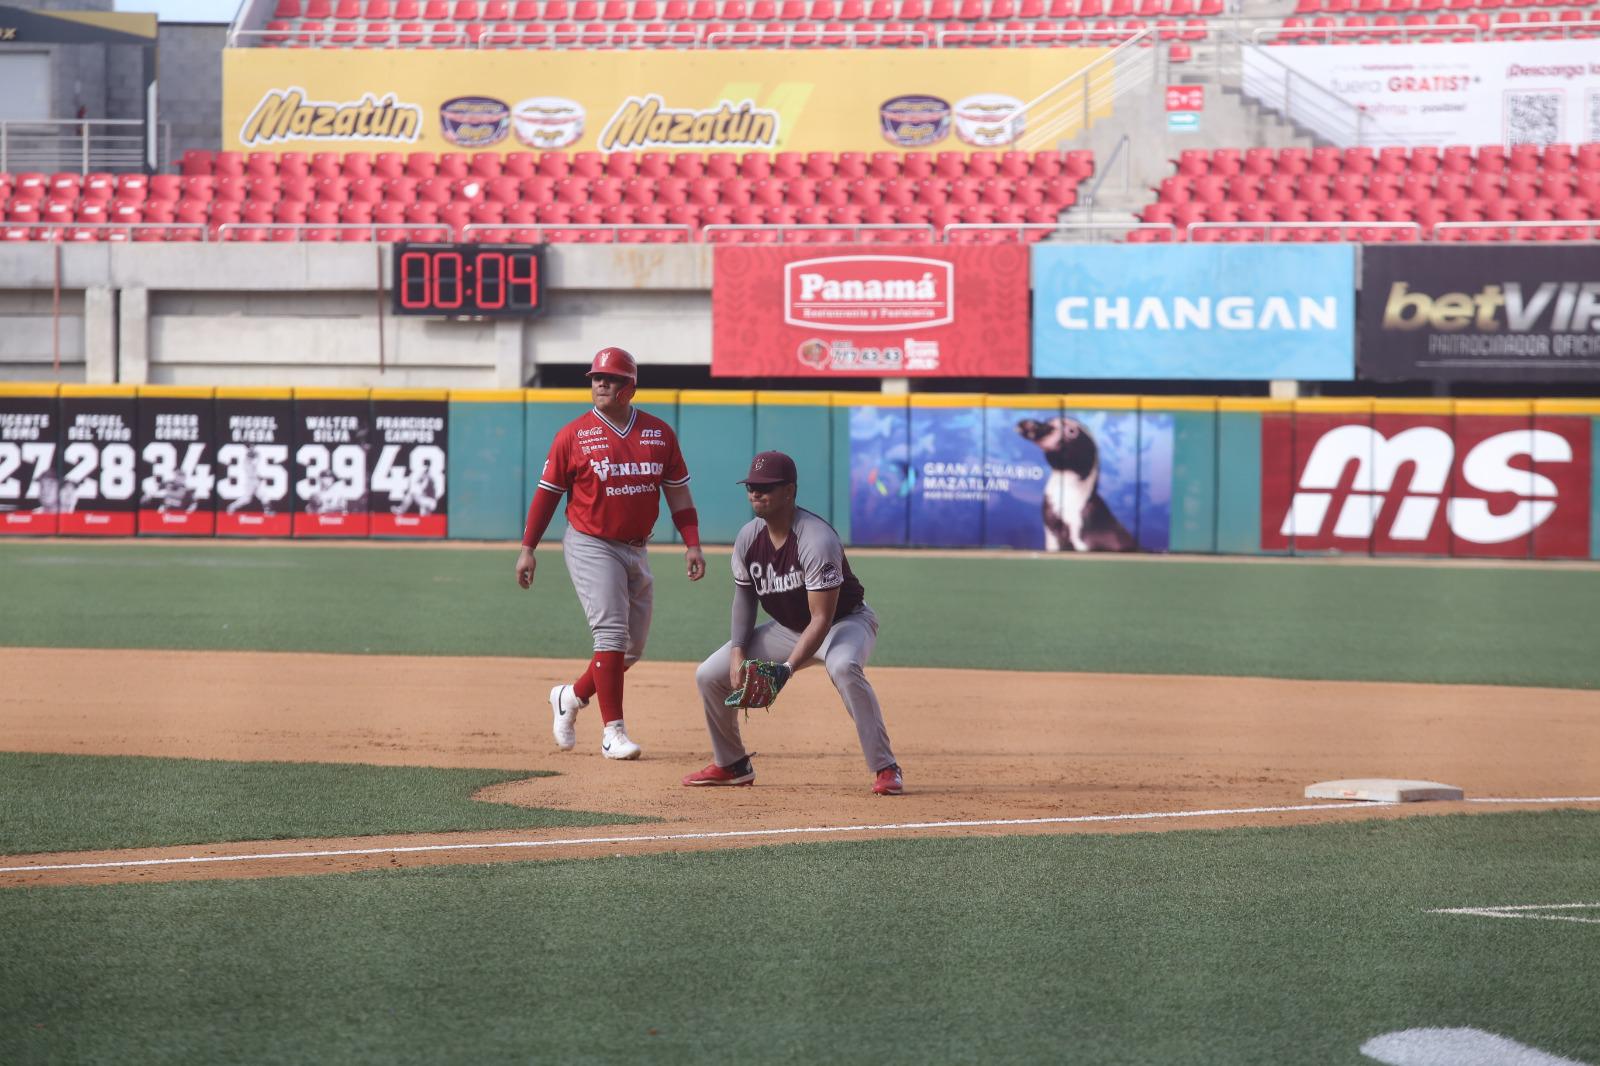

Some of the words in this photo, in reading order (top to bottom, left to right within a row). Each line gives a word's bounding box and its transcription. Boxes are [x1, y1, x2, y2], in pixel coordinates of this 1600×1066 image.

[401, 252, 538, 309] 00:04
[799, 272, 937, 301] Panamá
[1055, 296, 1337, 330] CHANGAN
[68, 426, 94, 440] DEL
[75, 414, 124, 429] MIGUEL
[229, 415, 278, 430] MIGUEL
[305, 416, 359, 430] WALTER
[376, 416, 444, 431] FRANCISCO
[313, 429, 351, 443] SILVA
[384, 429, 434, 443] CAMPOS
[0, 442, 56, 499] 27
[64, 442, 136, 500] 28
[142, 442, 215, 500] 34
[216, 443, 289, 500] 35
[296, 444, 367, 501] 39
[590, 457, 664, 481] VENADOS
[923, 462, 968, 477] GRAN
